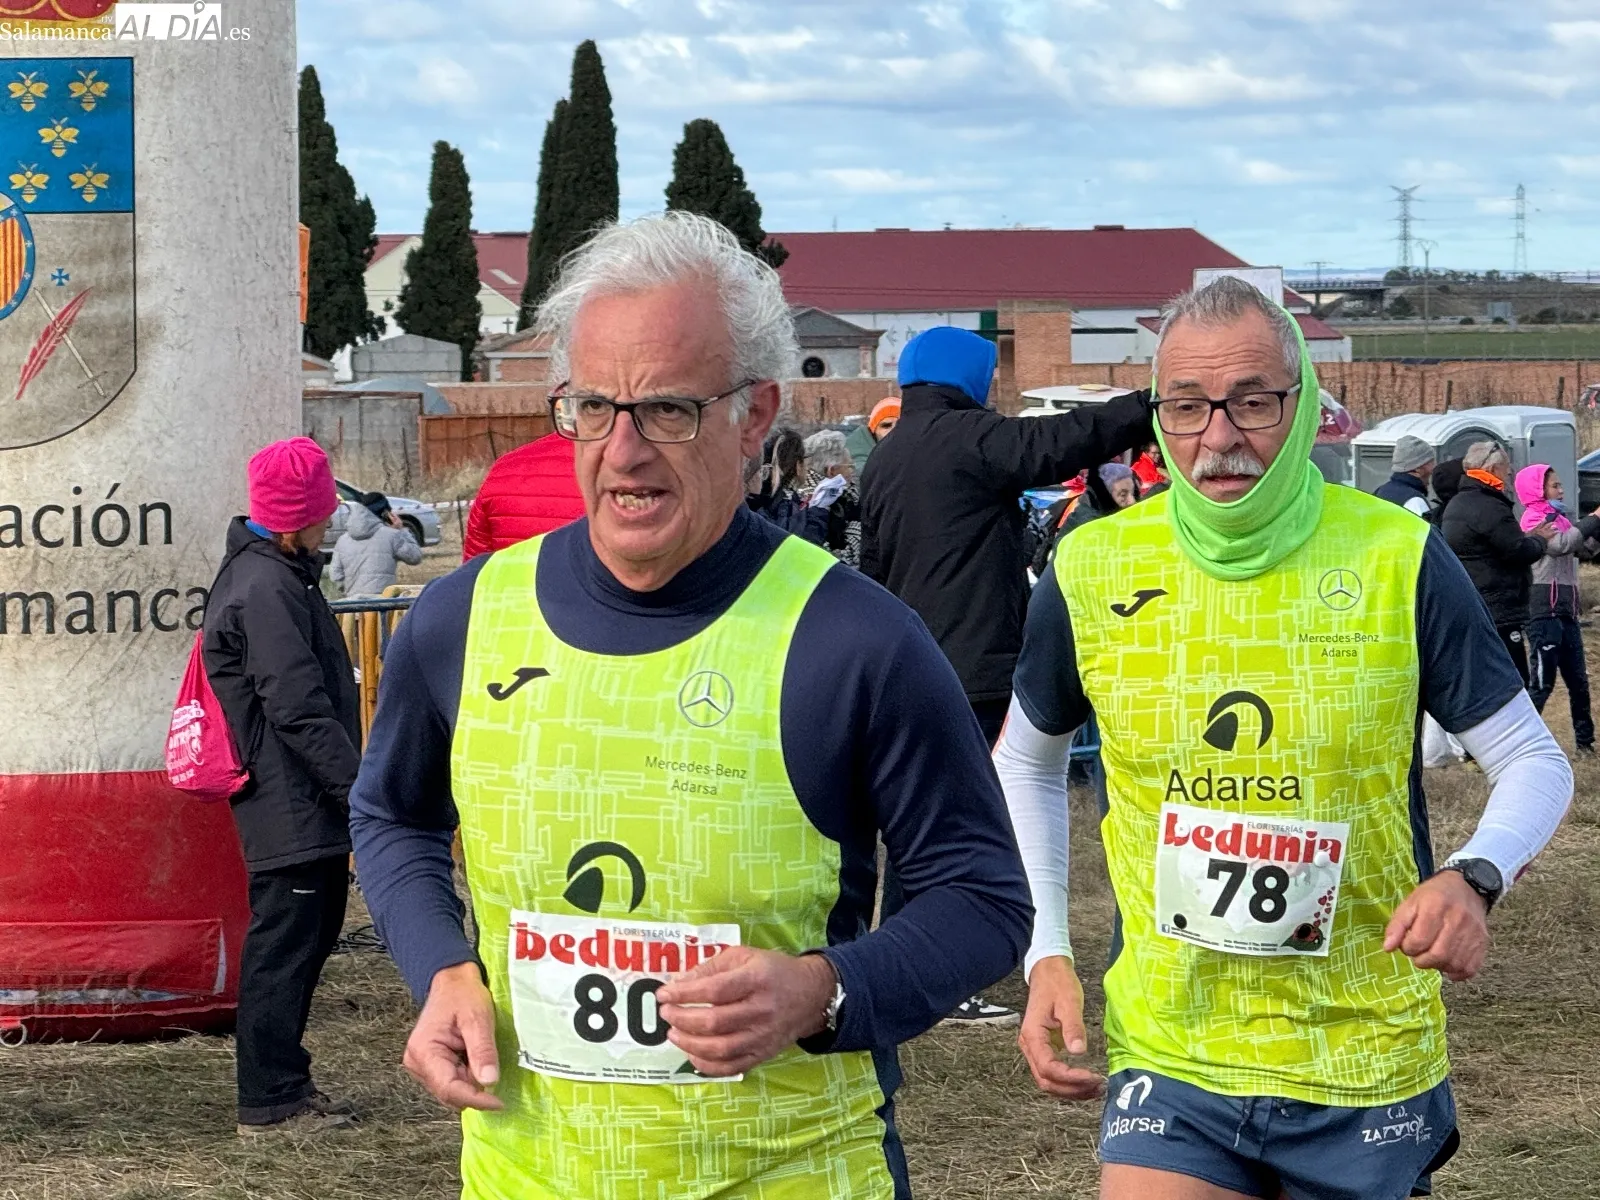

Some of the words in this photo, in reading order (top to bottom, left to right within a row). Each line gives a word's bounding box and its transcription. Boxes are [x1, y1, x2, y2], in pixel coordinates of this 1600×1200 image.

[1298, 632, 1380, 644] Mercedes-Benz
[1321, 647, 1358, 658] Adarsa
[645, 755, 748, 779] Mercedes-Benz
[671, 779, 718, 796] Adarsa
[1165, 767, 1303, 802] Adarsa
[1163, 811, 1343, 865] bedunia
[1206, 857, 1290, 924] 78
[573, 973, 672, 1047] 80
[1103, 1115, 1166, 1144] Adarsa
